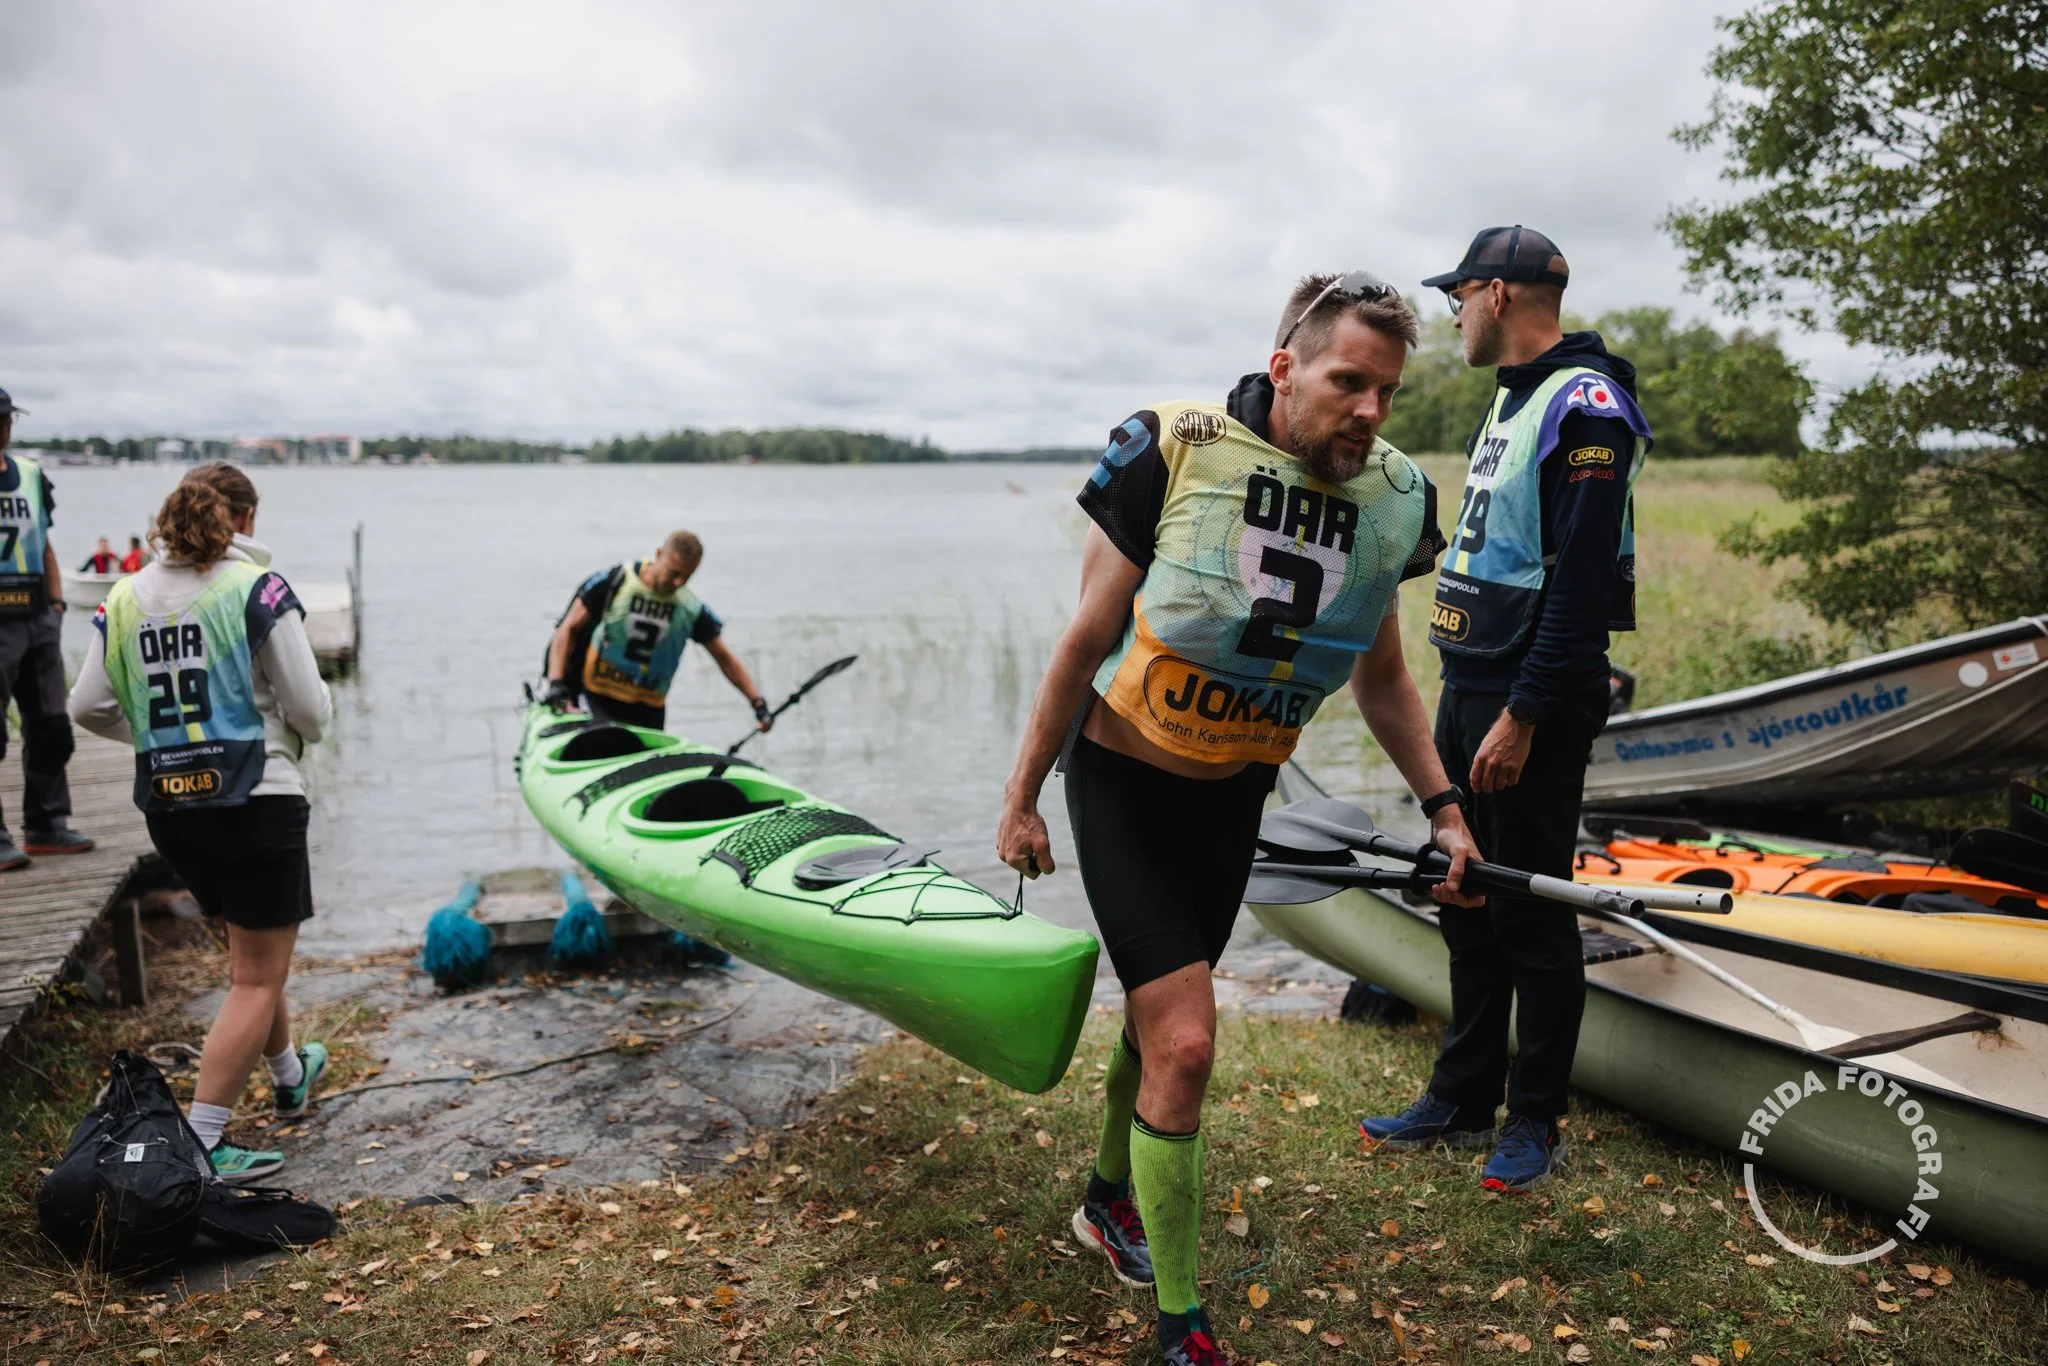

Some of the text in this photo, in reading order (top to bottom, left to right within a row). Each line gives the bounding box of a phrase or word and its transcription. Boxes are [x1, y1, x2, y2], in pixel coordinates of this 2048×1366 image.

[1575, 449, 1609, 461] JOKAB
[0, 497, 31, 520] AR
[1243, 465, 1359, 555] ÖAR
[0, 592, 31, 607] OKAB
[1235, 545, 1325, 663] 2
[139, 624, 203, 664] ÖAR
[624, 620, 660, 664] 2
[148, 668, 213, 731] 29
[1164, 672, 1311, 730] JOKAB
[1158, 716, 1194, 738] John
[1198, 727, 1248, 746] Karlsson
[162, 773, 214, 794] JOKAB
